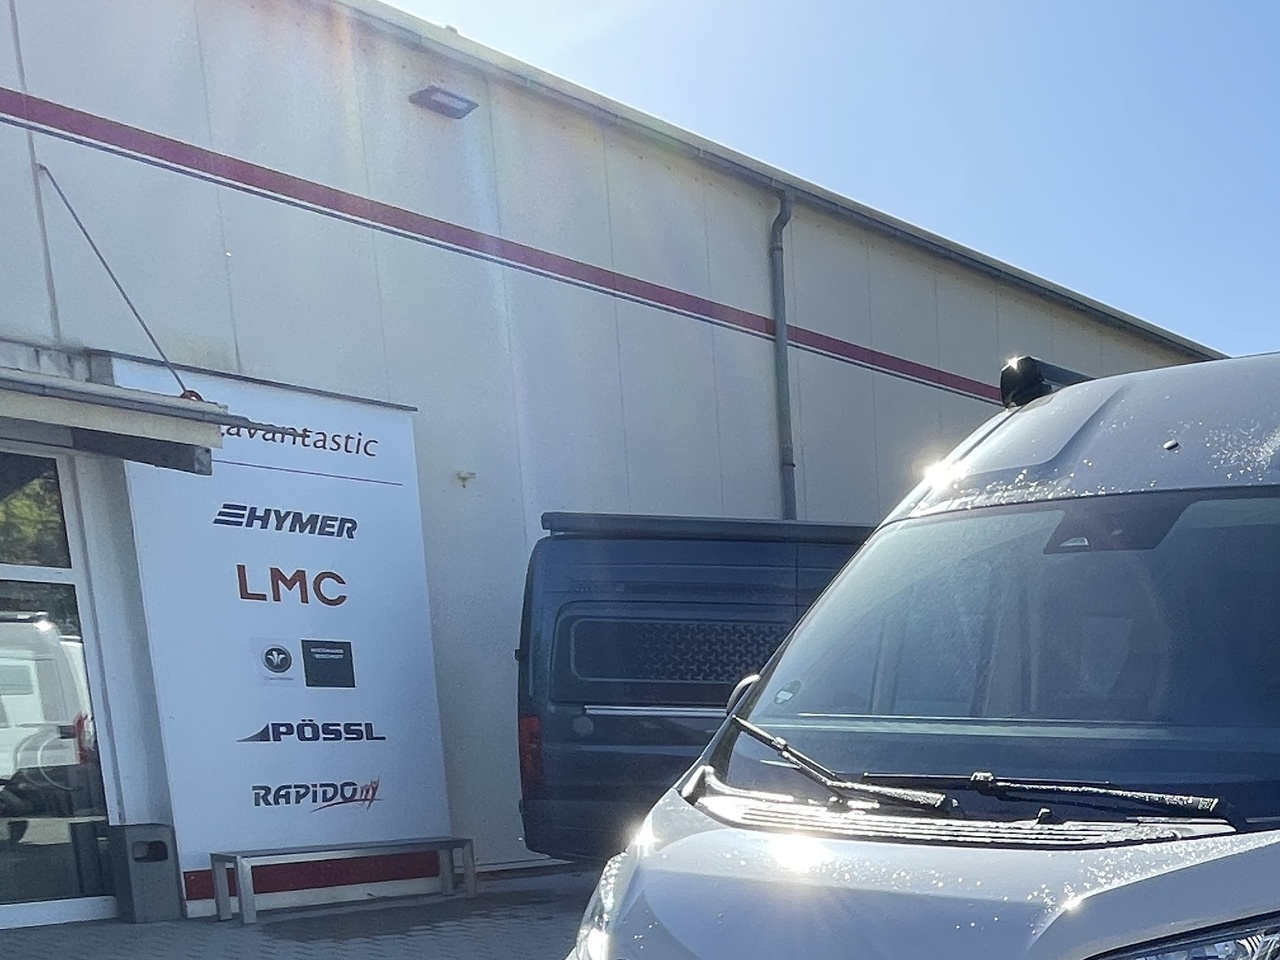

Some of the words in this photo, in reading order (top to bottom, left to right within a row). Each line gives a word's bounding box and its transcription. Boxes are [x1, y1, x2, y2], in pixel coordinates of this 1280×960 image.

[245, 506, 358, 539] HYMER
[236, 564, 347, 606] LMC
[269, 718, 386, 742] PÖSSL
